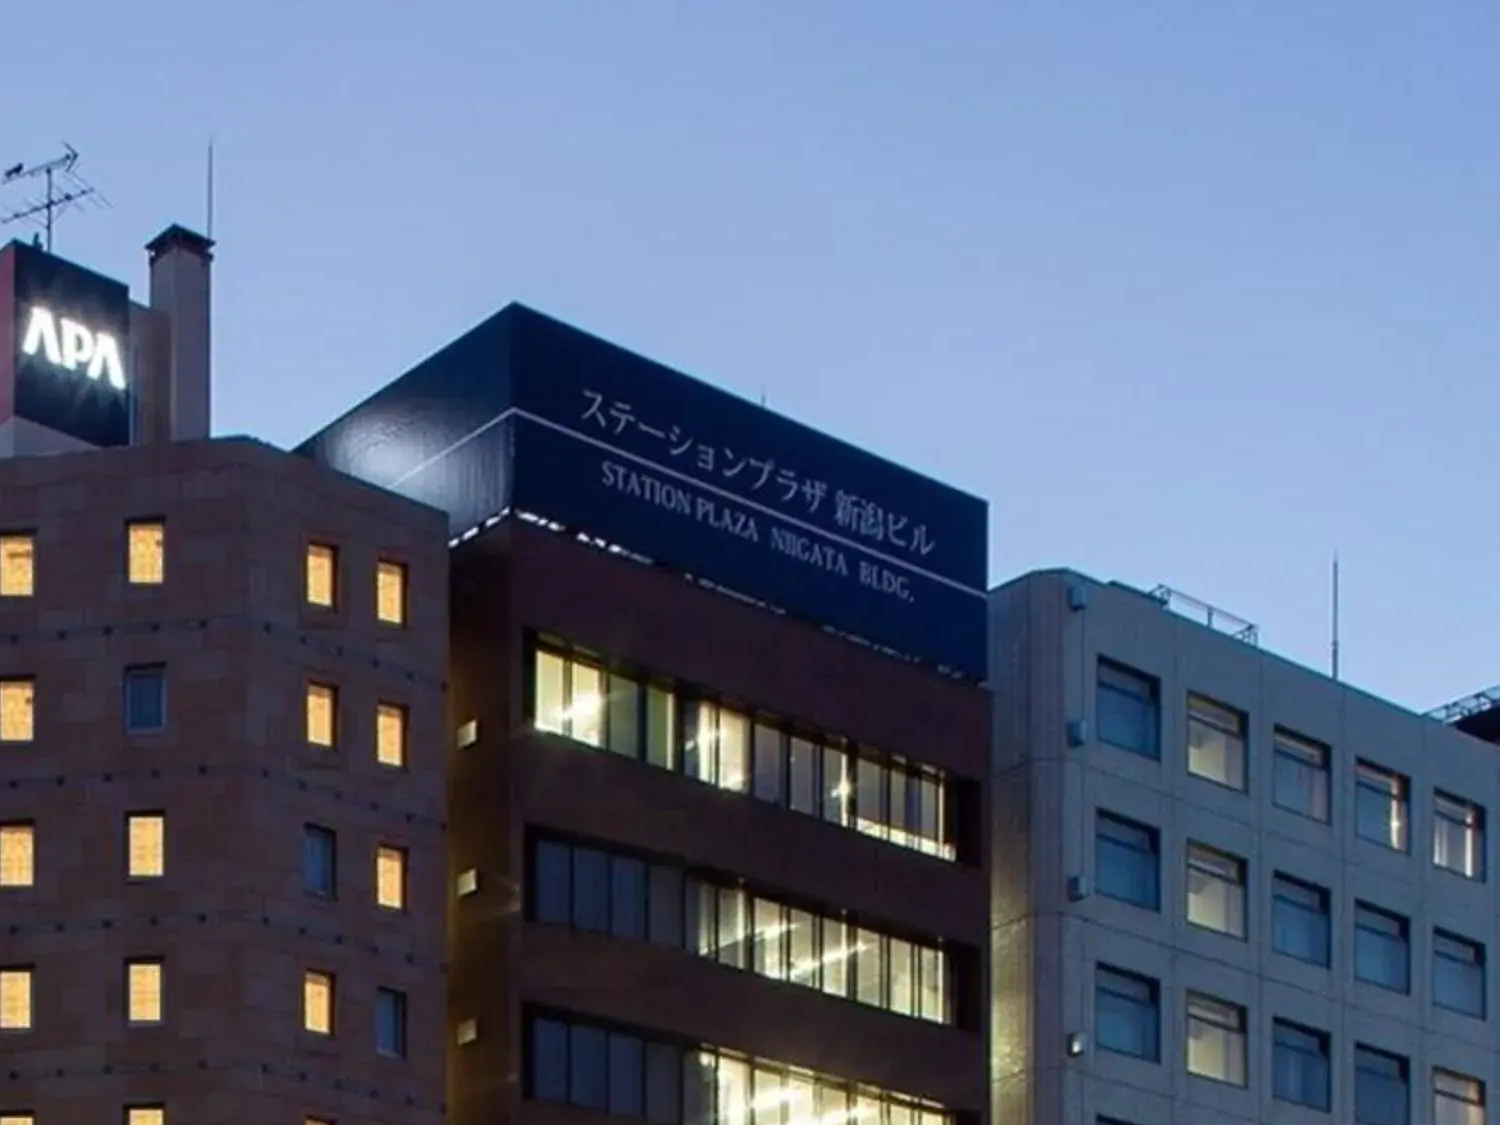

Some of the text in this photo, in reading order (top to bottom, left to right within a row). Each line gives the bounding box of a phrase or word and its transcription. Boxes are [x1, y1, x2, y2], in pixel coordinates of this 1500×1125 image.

[21, 305, 126, 390] APA
[581, 388, 936, 557] ステーションプラザ 新潟ビル
[601, 460, 916, 603] STATION PLAZA NIIGATA BLDG.
